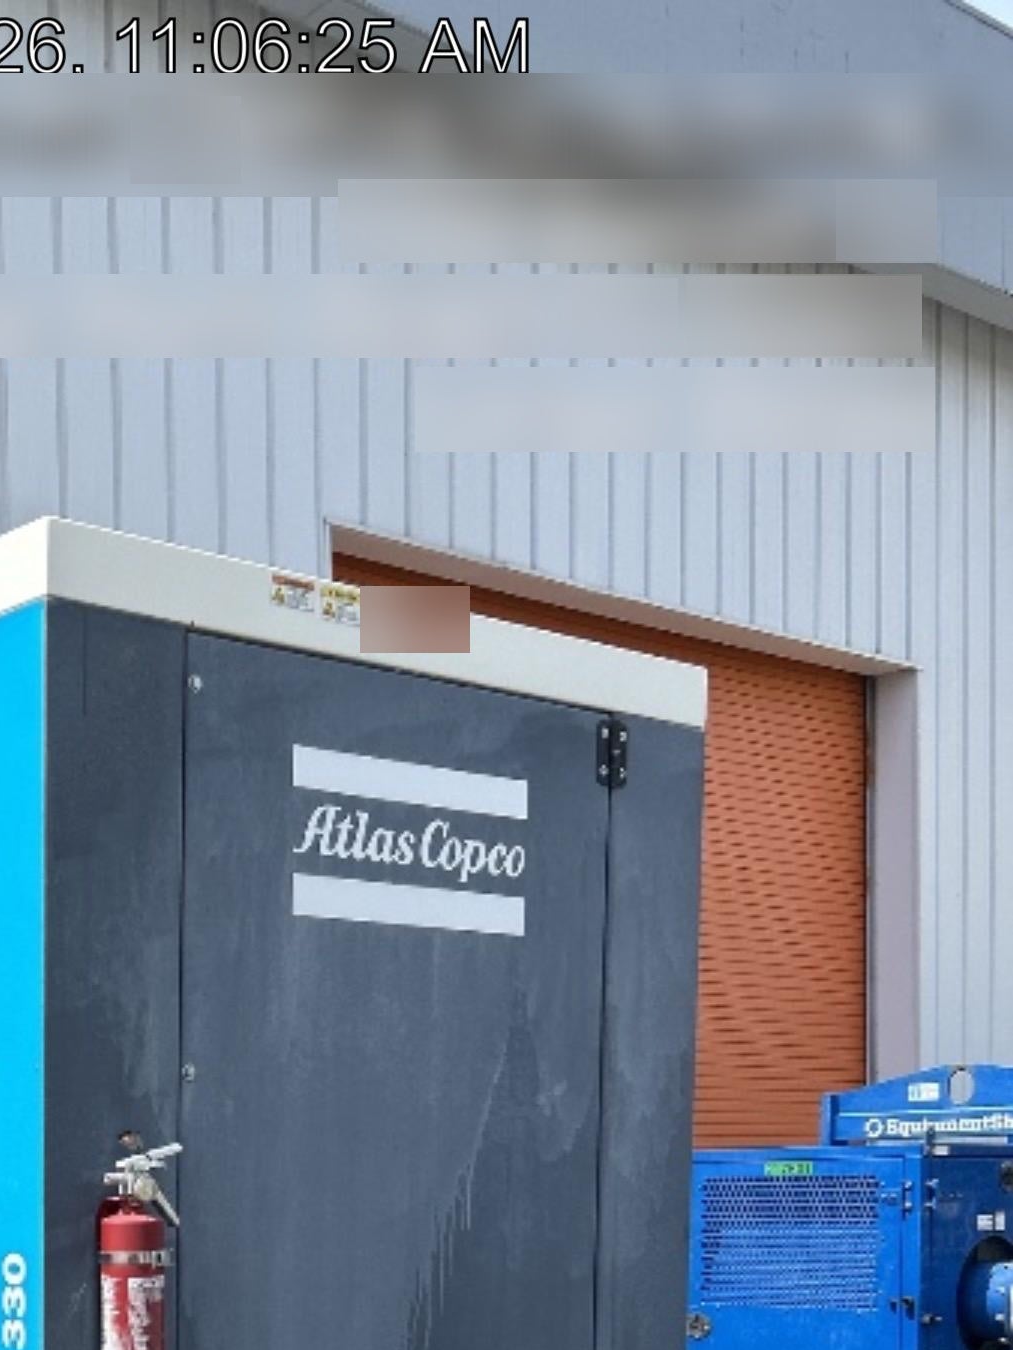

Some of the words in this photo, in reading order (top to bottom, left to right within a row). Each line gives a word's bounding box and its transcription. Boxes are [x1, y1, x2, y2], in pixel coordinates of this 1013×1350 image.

[292, 803, 415, 865] Atlas
[421, 818, 526, 883] Copco
[1, 1252, 27, 1350] 330
